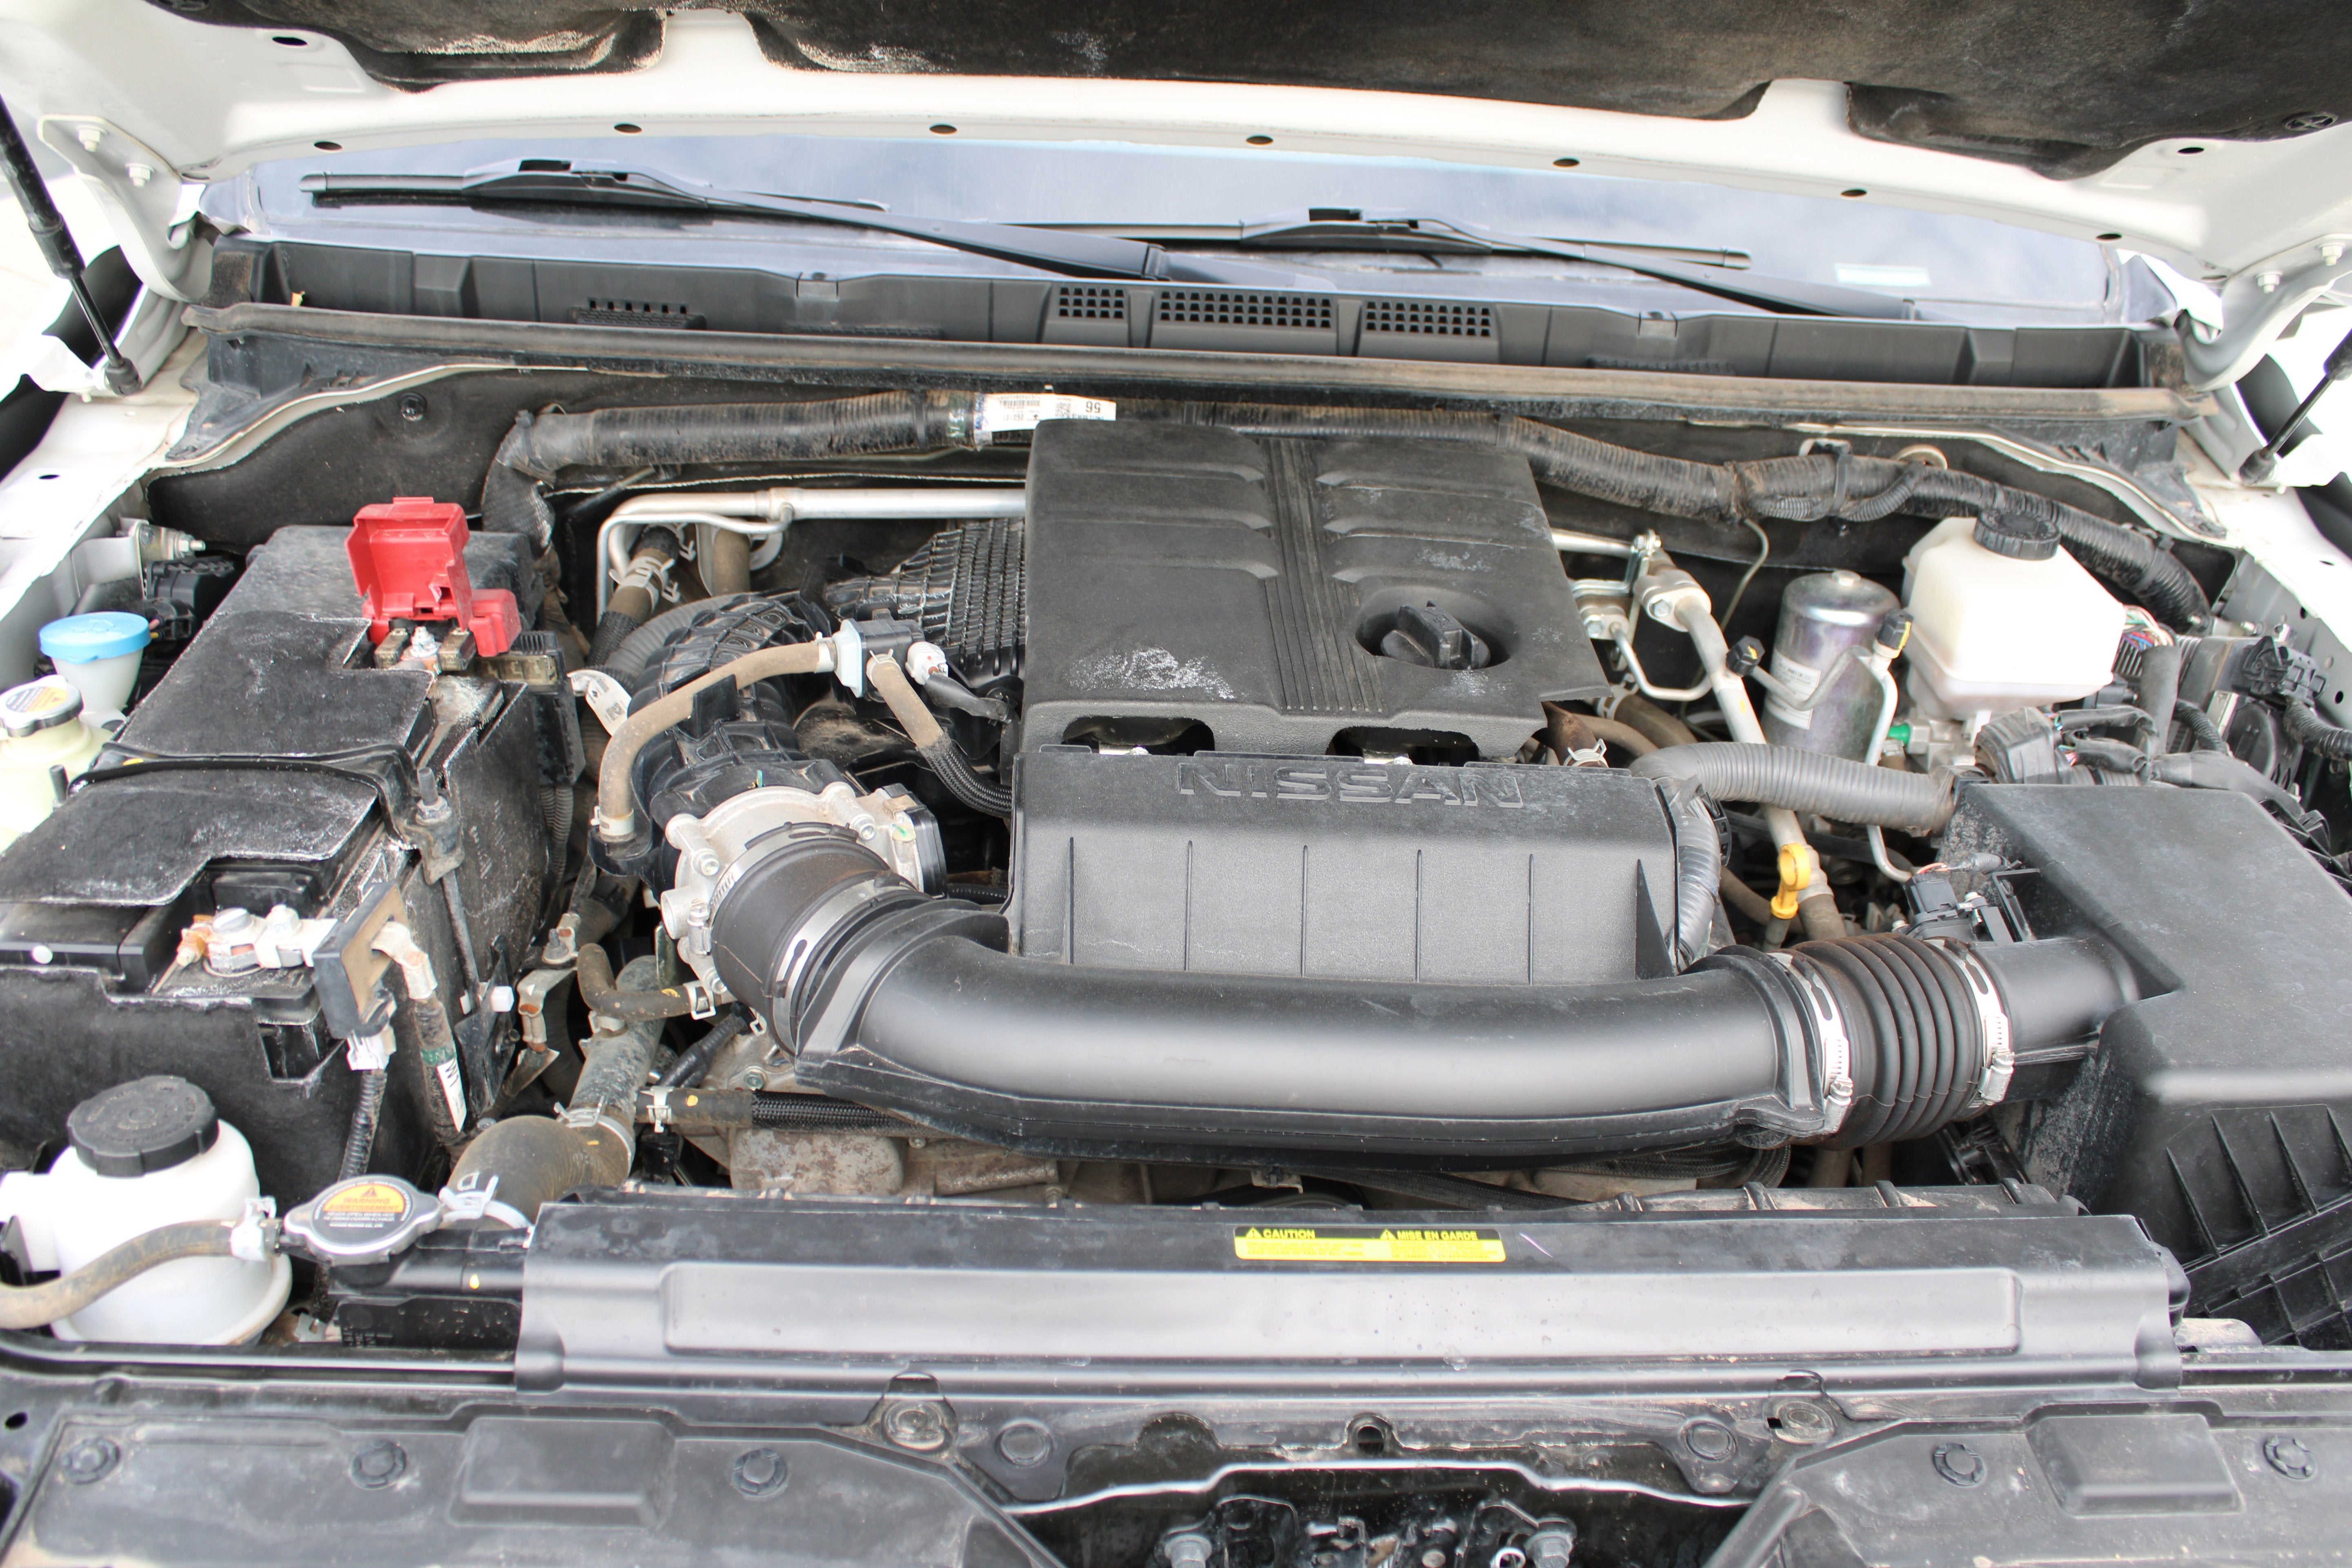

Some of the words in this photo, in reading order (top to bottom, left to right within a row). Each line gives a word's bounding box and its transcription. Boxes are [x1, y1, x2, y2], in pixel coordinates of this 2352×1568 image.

[1085, 401, 1101, 413] 56
[1178, 763, 1523, 808] NISSAN
[1263, 1229, 1315, 1239] CAUTION
[1396, 1230, 1423, 1240] MISE
[1424, 1230, 1439, 1240] EN
[1440, 1231, 1479, 1241] GARDE
